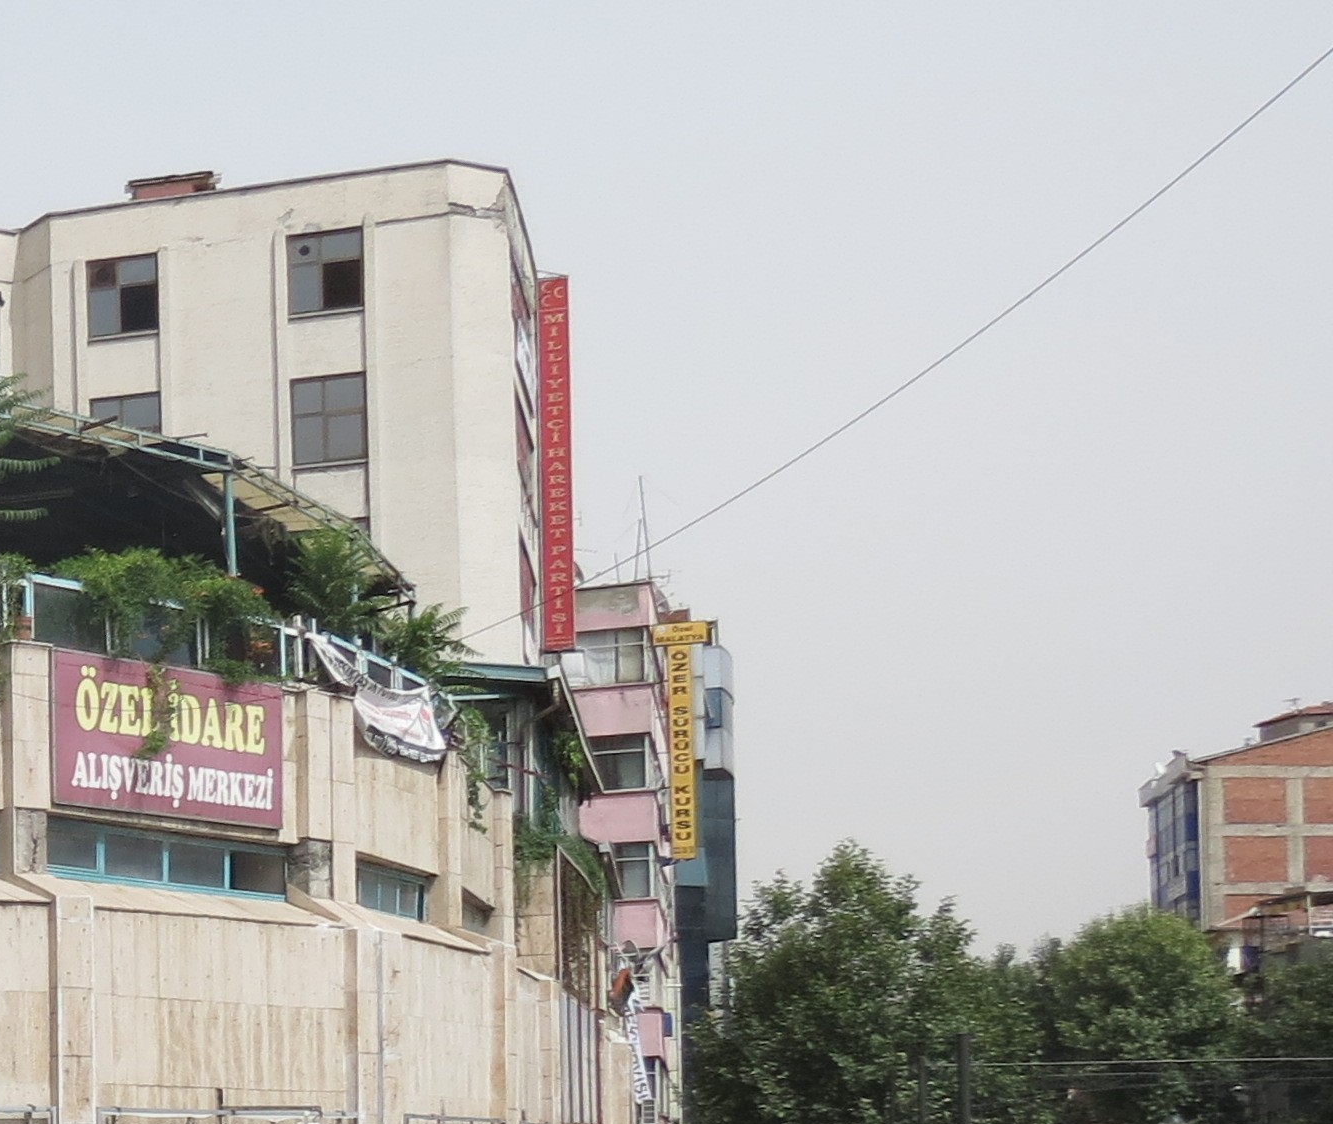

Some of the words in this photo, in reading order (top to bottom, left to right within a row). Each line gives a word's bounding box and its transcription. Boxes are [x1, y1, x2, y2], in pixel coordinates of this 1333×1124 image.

[546, 448, 568, 539] HAREKET
[71, 751, 185, 808] ALIŞVERİŞ
[187, 767, 274, 810] MERKEZİ
[674, 785, 693, 841] KURSU
